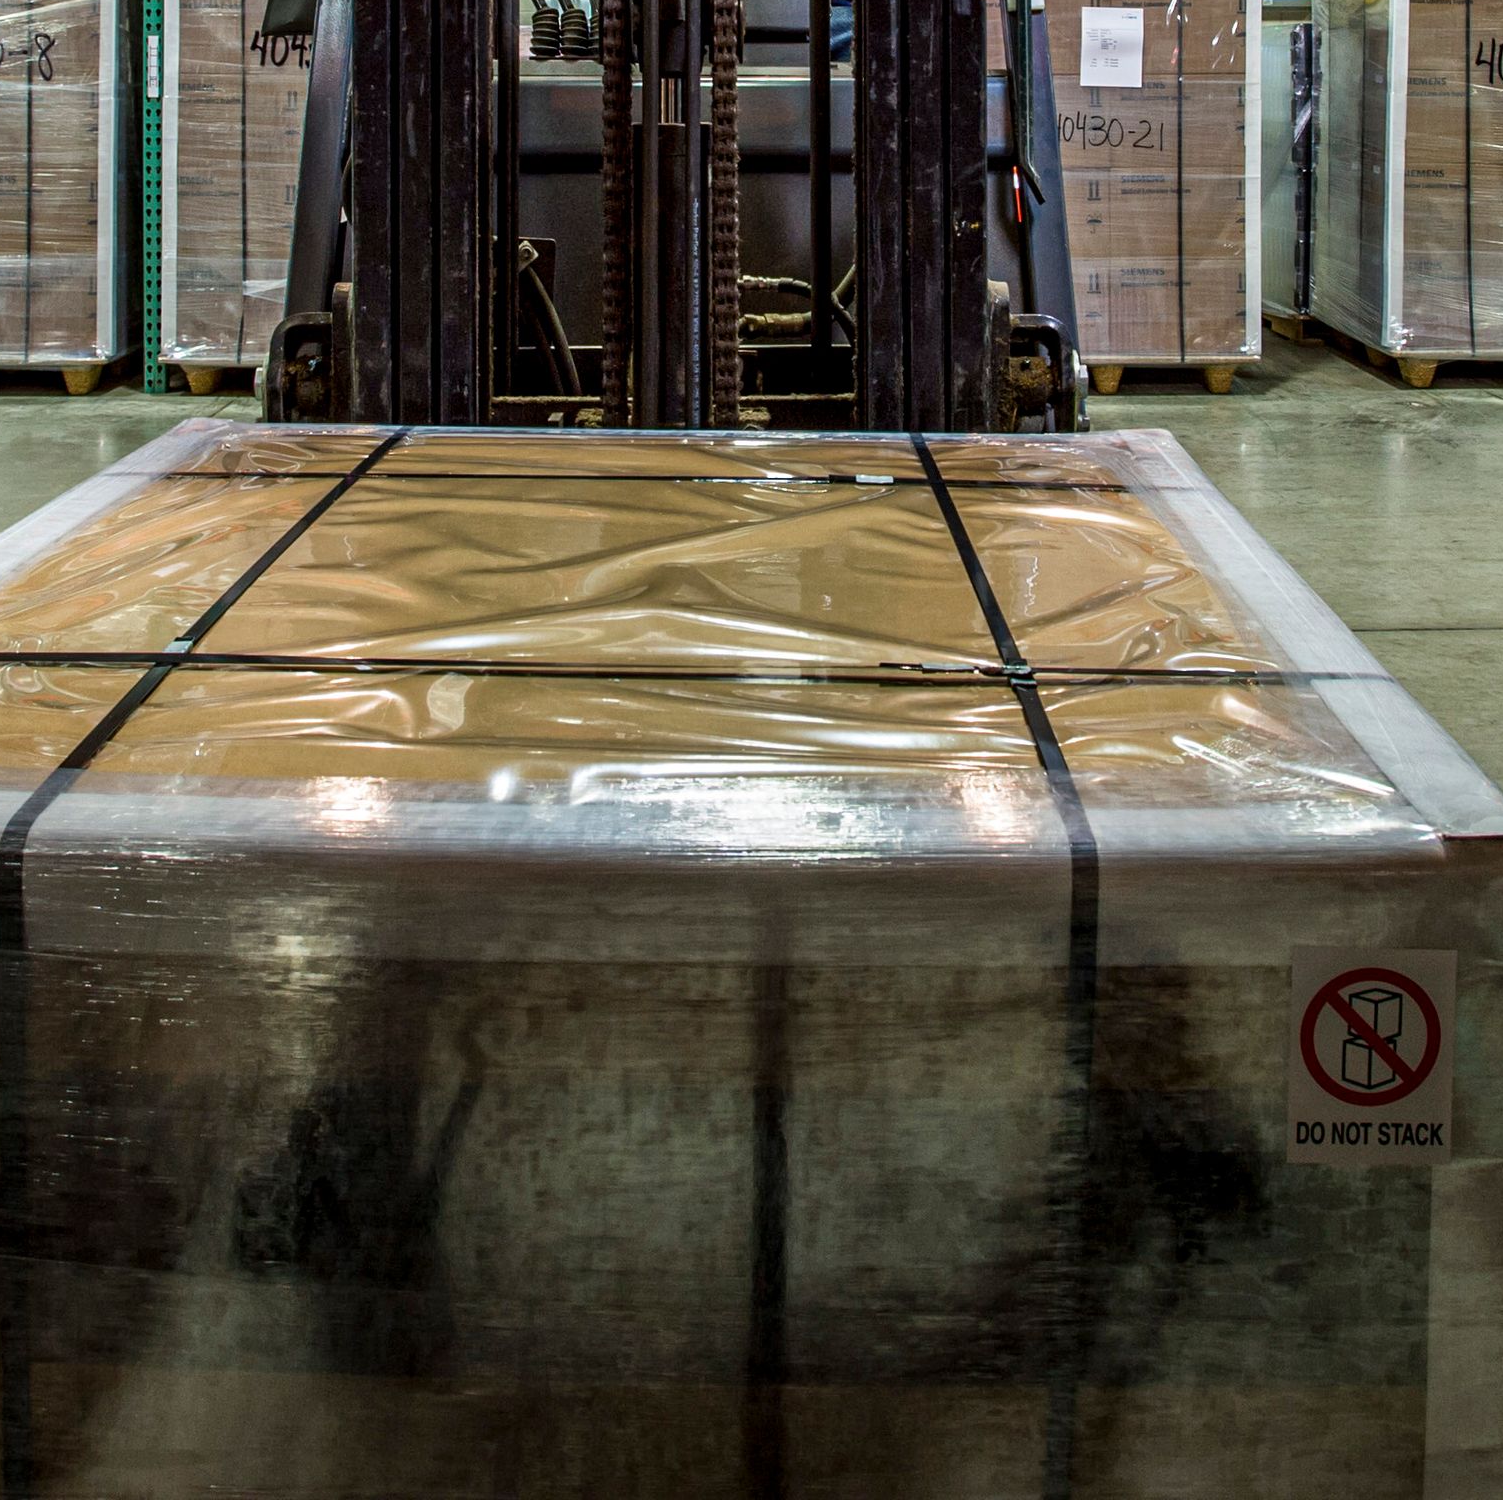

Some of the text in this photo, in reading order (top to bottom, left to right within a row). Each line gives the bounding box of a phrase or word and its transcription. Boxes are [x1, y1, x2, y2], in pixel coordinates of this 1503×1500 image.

[250, 30, 313, 68] 404
[1405, 169, 1444, 177] IEMENS
[1296, 1121, 1444, 1146] DO NOT STACK
